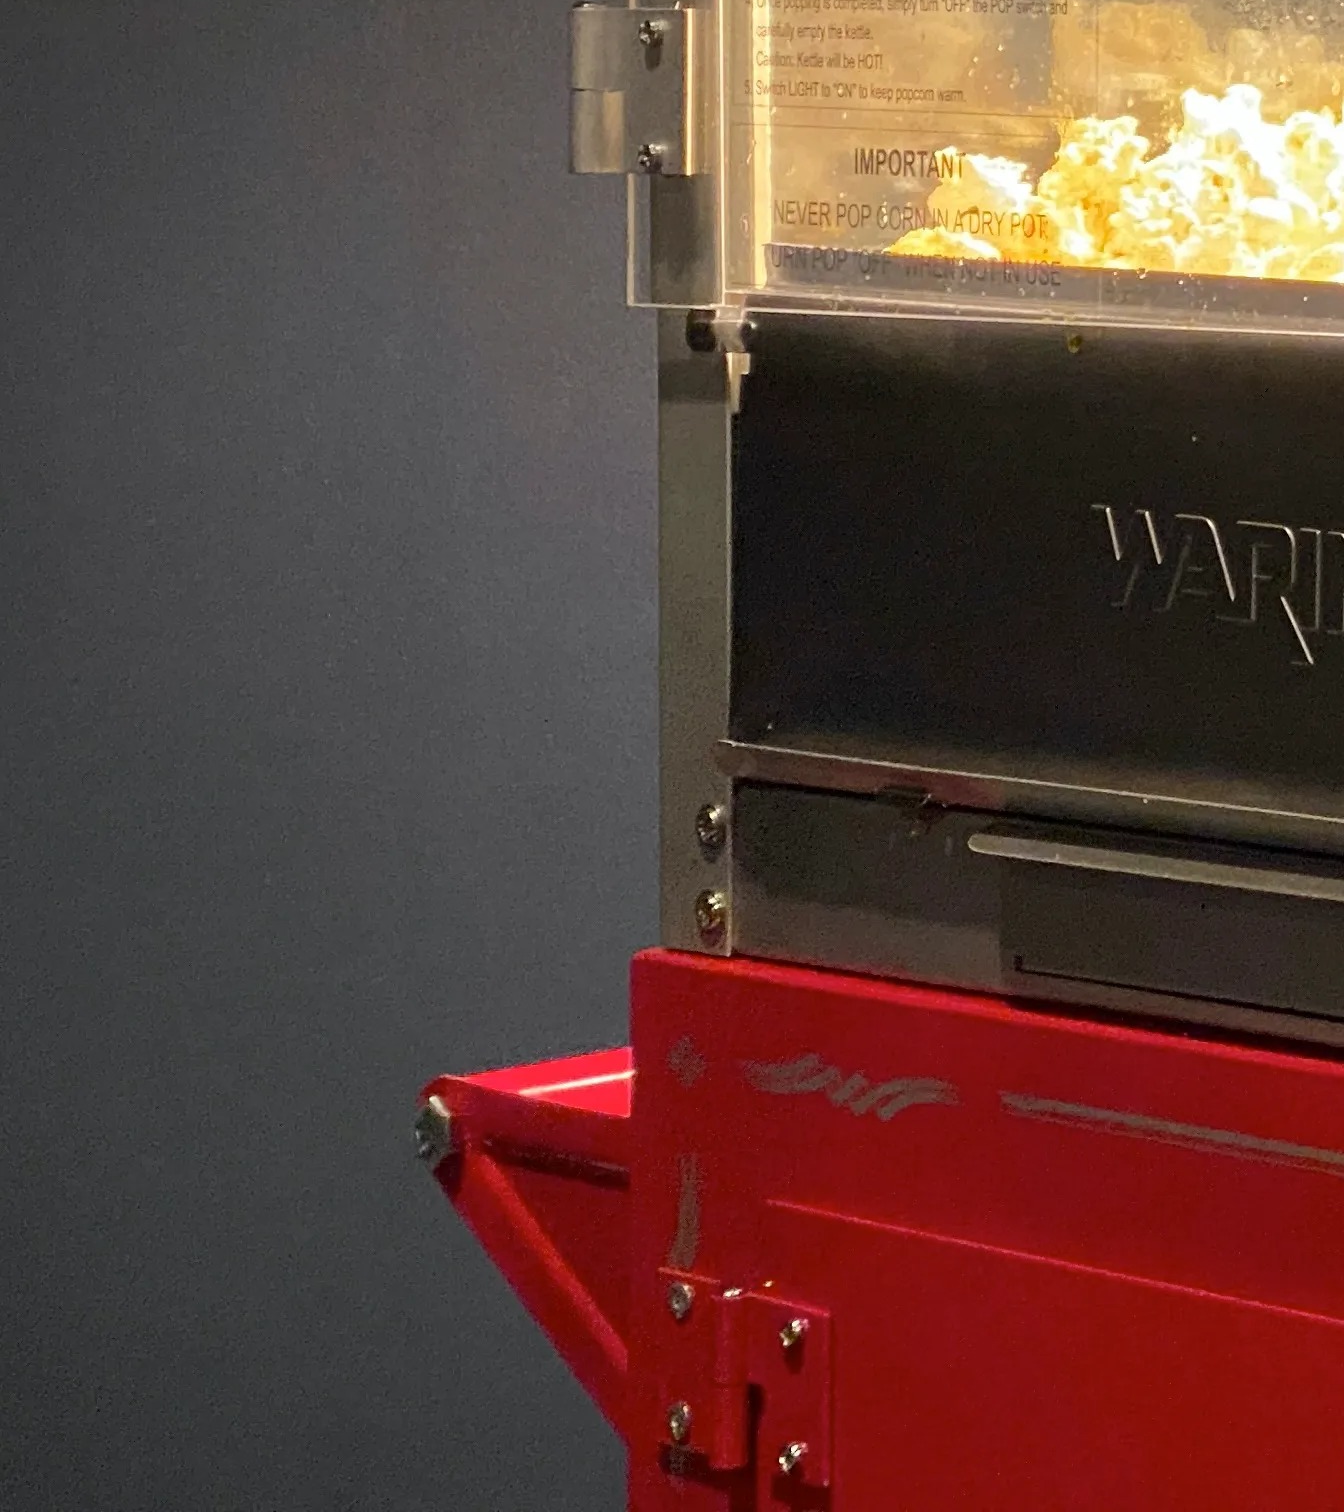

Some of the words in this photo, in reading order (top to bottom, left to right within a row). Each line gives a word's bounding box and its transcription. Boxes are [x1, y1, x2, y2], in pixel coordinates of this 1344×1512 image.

[788, 80, 820, 98] LIGHT
[853, 146, 967, 180] IMPORTANT
[773, 198, 831, 227] NEVER
[835, 202, 872, 230] POP
[875, 203, 927, 233] CORN
[931, 206, 949, 234] IN
[953, 208, 964, 233] A
[967, 208, 1005, 236] DRY
[769, 243, 807, 270] URN
[810, 246, 848, 273] POP
